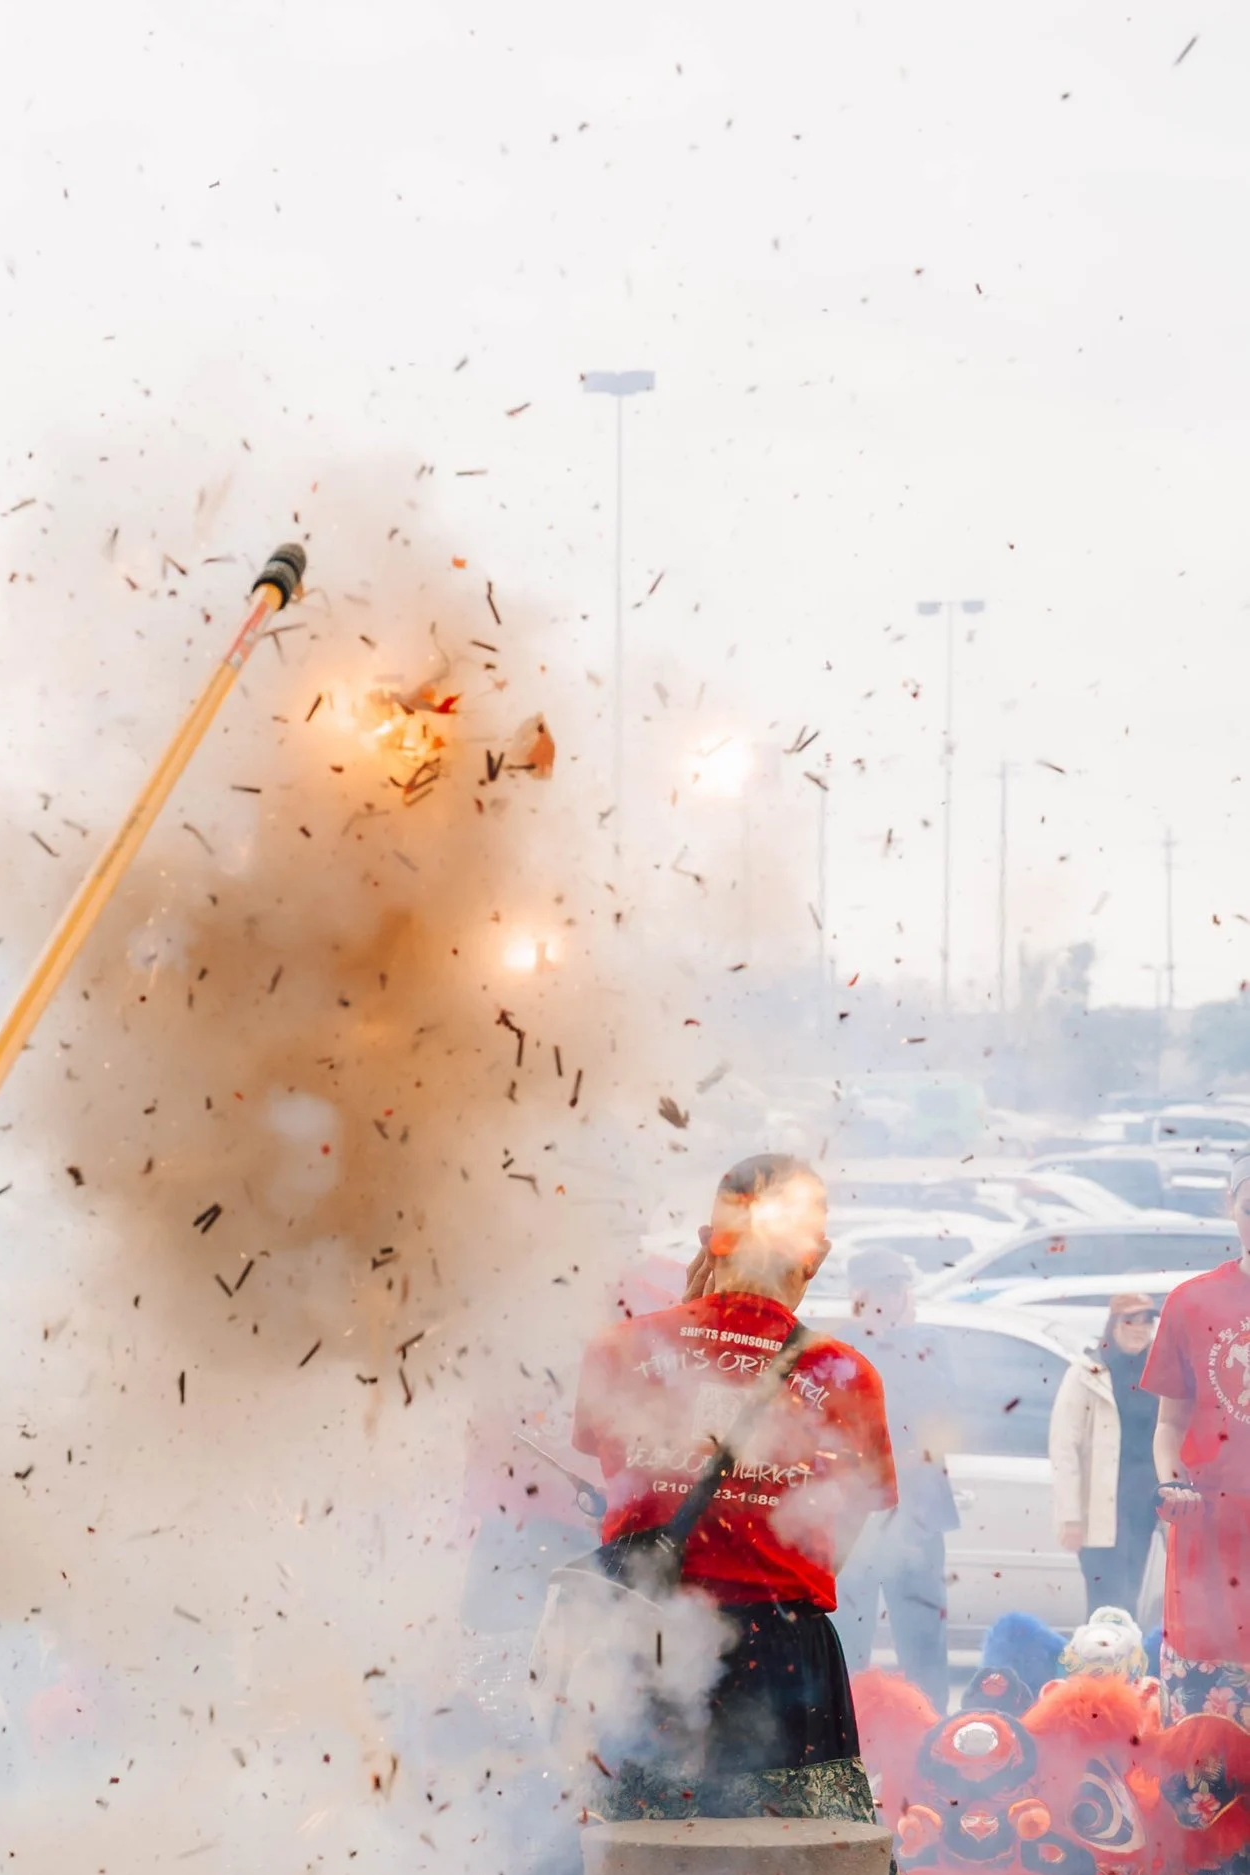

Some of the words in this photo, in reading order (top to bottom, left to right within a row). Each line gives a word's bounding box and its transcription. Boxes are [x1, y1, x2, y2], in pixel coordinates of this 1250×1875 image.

[720, 1330, 783, 1352] SPONSORED
[1208, 1343, 1222, 1366] SAN
[712, 1488, 780, 1506] 23-1688
